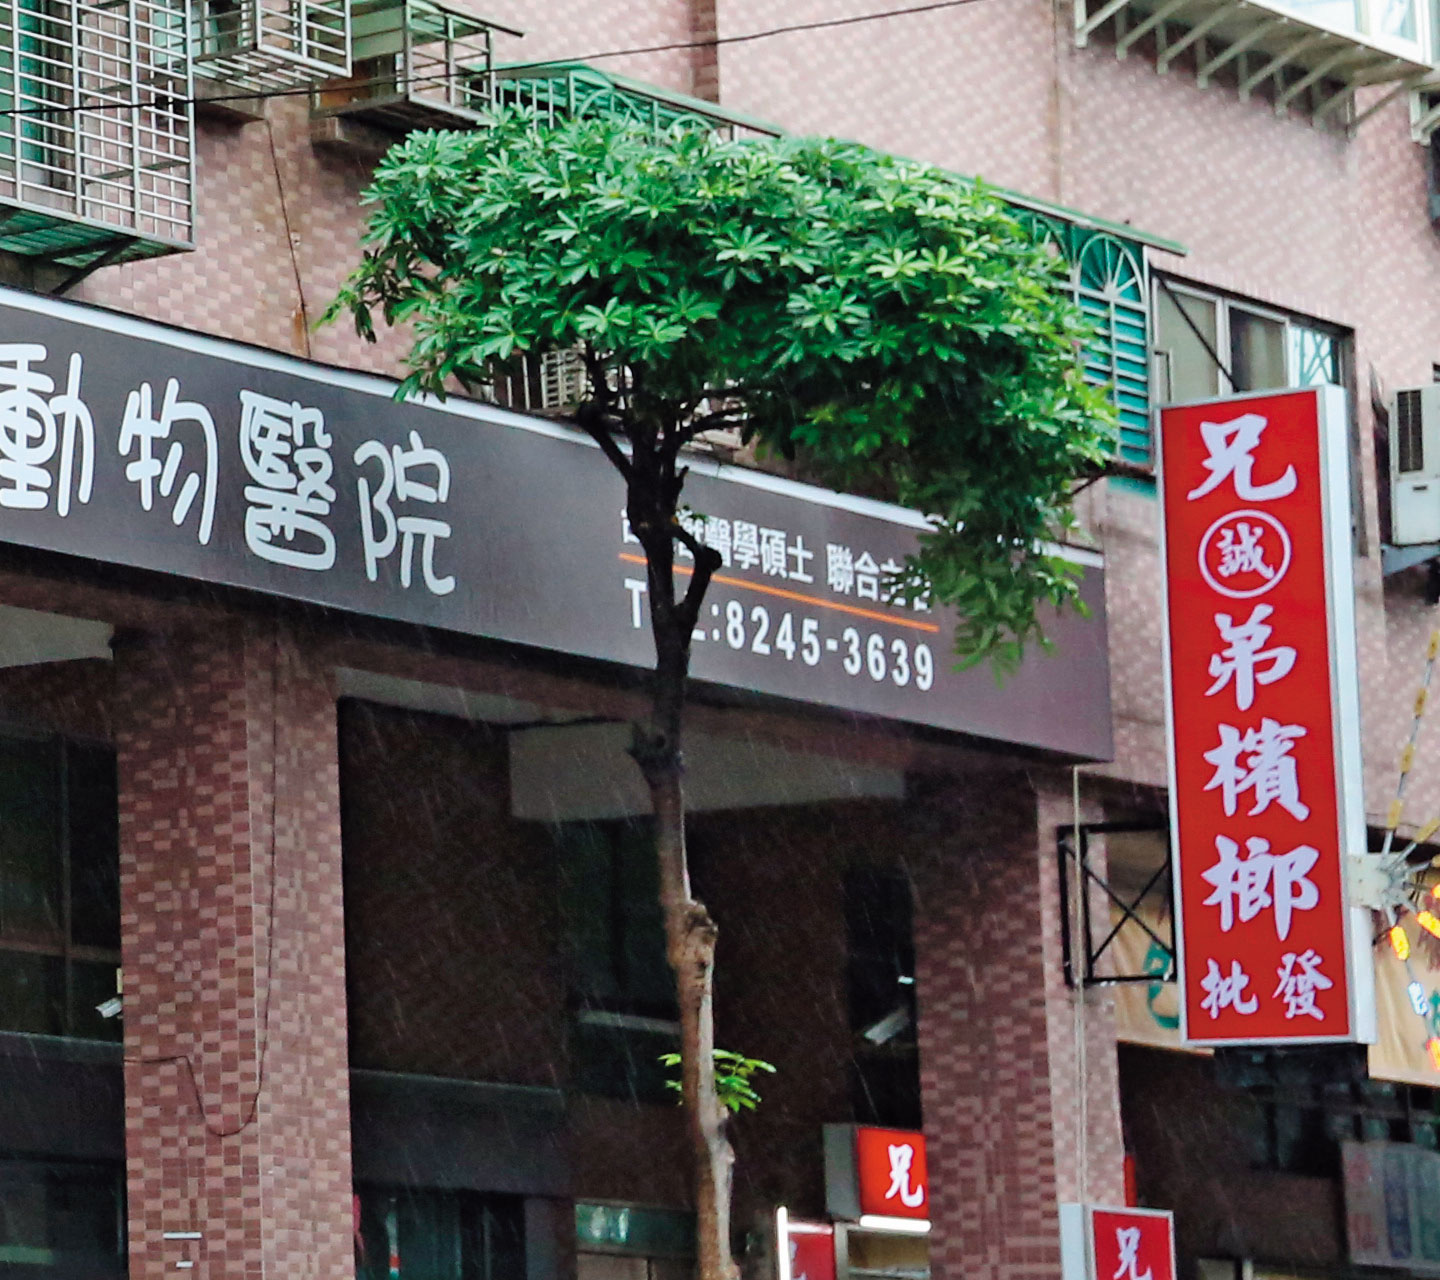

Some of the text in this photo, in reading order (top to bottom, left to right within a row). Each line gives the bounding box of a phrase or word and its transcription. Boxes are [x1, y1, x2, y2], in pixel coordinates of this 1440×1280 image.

[624, 577, 934, 691] T:8245-3639
[1200, 948, 1333, 1021] 批發
[884, 1143, 925, 1209] 兄
